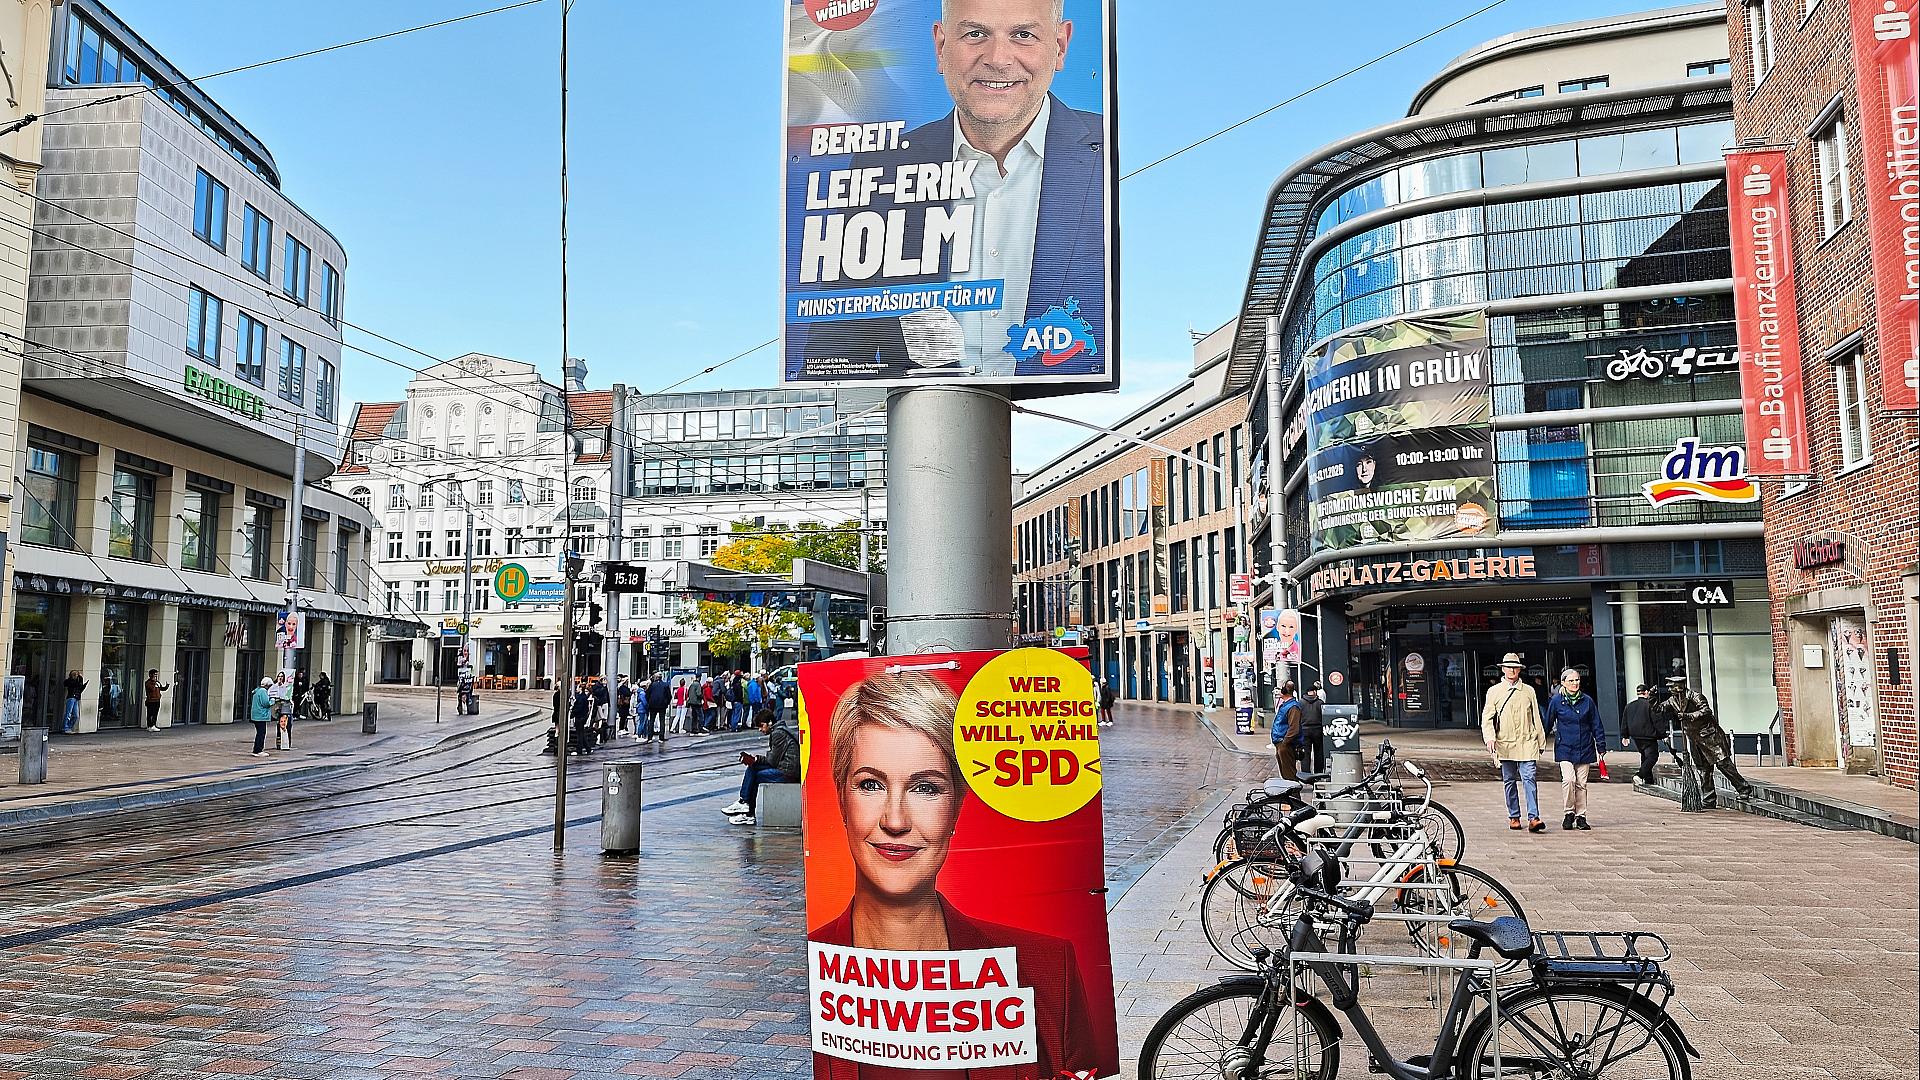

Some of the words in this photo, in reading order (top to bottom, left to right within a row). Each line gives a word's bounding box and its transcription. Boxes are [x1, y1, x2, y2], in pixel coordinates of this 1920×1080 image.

[810, 121, 909, 156] BEREIT.
[805, 160, 979, 210] LEIF-ERIK
[799, 205, 975, 284] HOLM
[797, 290, 942, 317] MINISTERPRÄSIDENT
[944, 285, 970, 306] FÜR
[971, 287, 996, 306] MV
[1750, 206, 1785, 416] Baufinanzierung
[1021, 326, 1073, 351] AfD
[1697, 351, 1742, 366] CU
[1377, 364, 1401, 393] IN
[1409, 352, 1481, 387] GRÜN
[184, 365, 266, 420] BARMER
[1396, 448, 1460, 466] 10:00-19:00
[1462, 447, 1484, 460] Uhr
[1666, 441, 1740, 480] dm
[1423, 485, 1457, 502] ZUM
[1369, 508, 1386, 522] DER
[1387, 503, 1457, 520] BUNDESWEHR
[422, 560, 483, 576] Schwerier
[614, 572, 639, 585] 15:18
[1310, 555, 1536, 592] ARIENPLATZ-GALERIE
[504, 571, 520, 594] H
[528, 588, 565, 597] Marienplatz
[1692, 586, 1729, 604] C&A
[1009, 677, 1061, 693] WER
[976, 701, 1094, 717] SCHWESIG
[960, 727, 1025, 745] WILL,
[1032, 720, 1099, 742] WÄHL
[819, 951, 1008, 991] MANUELA
[821, 991, 1025, 1033] SCHWESIG
[821, 1033, 942, 1061] ENTSCHEIDUNG
[946, 1041, 986, 1061] FÜR
[993, 1041, 1029, 1058] MV.
